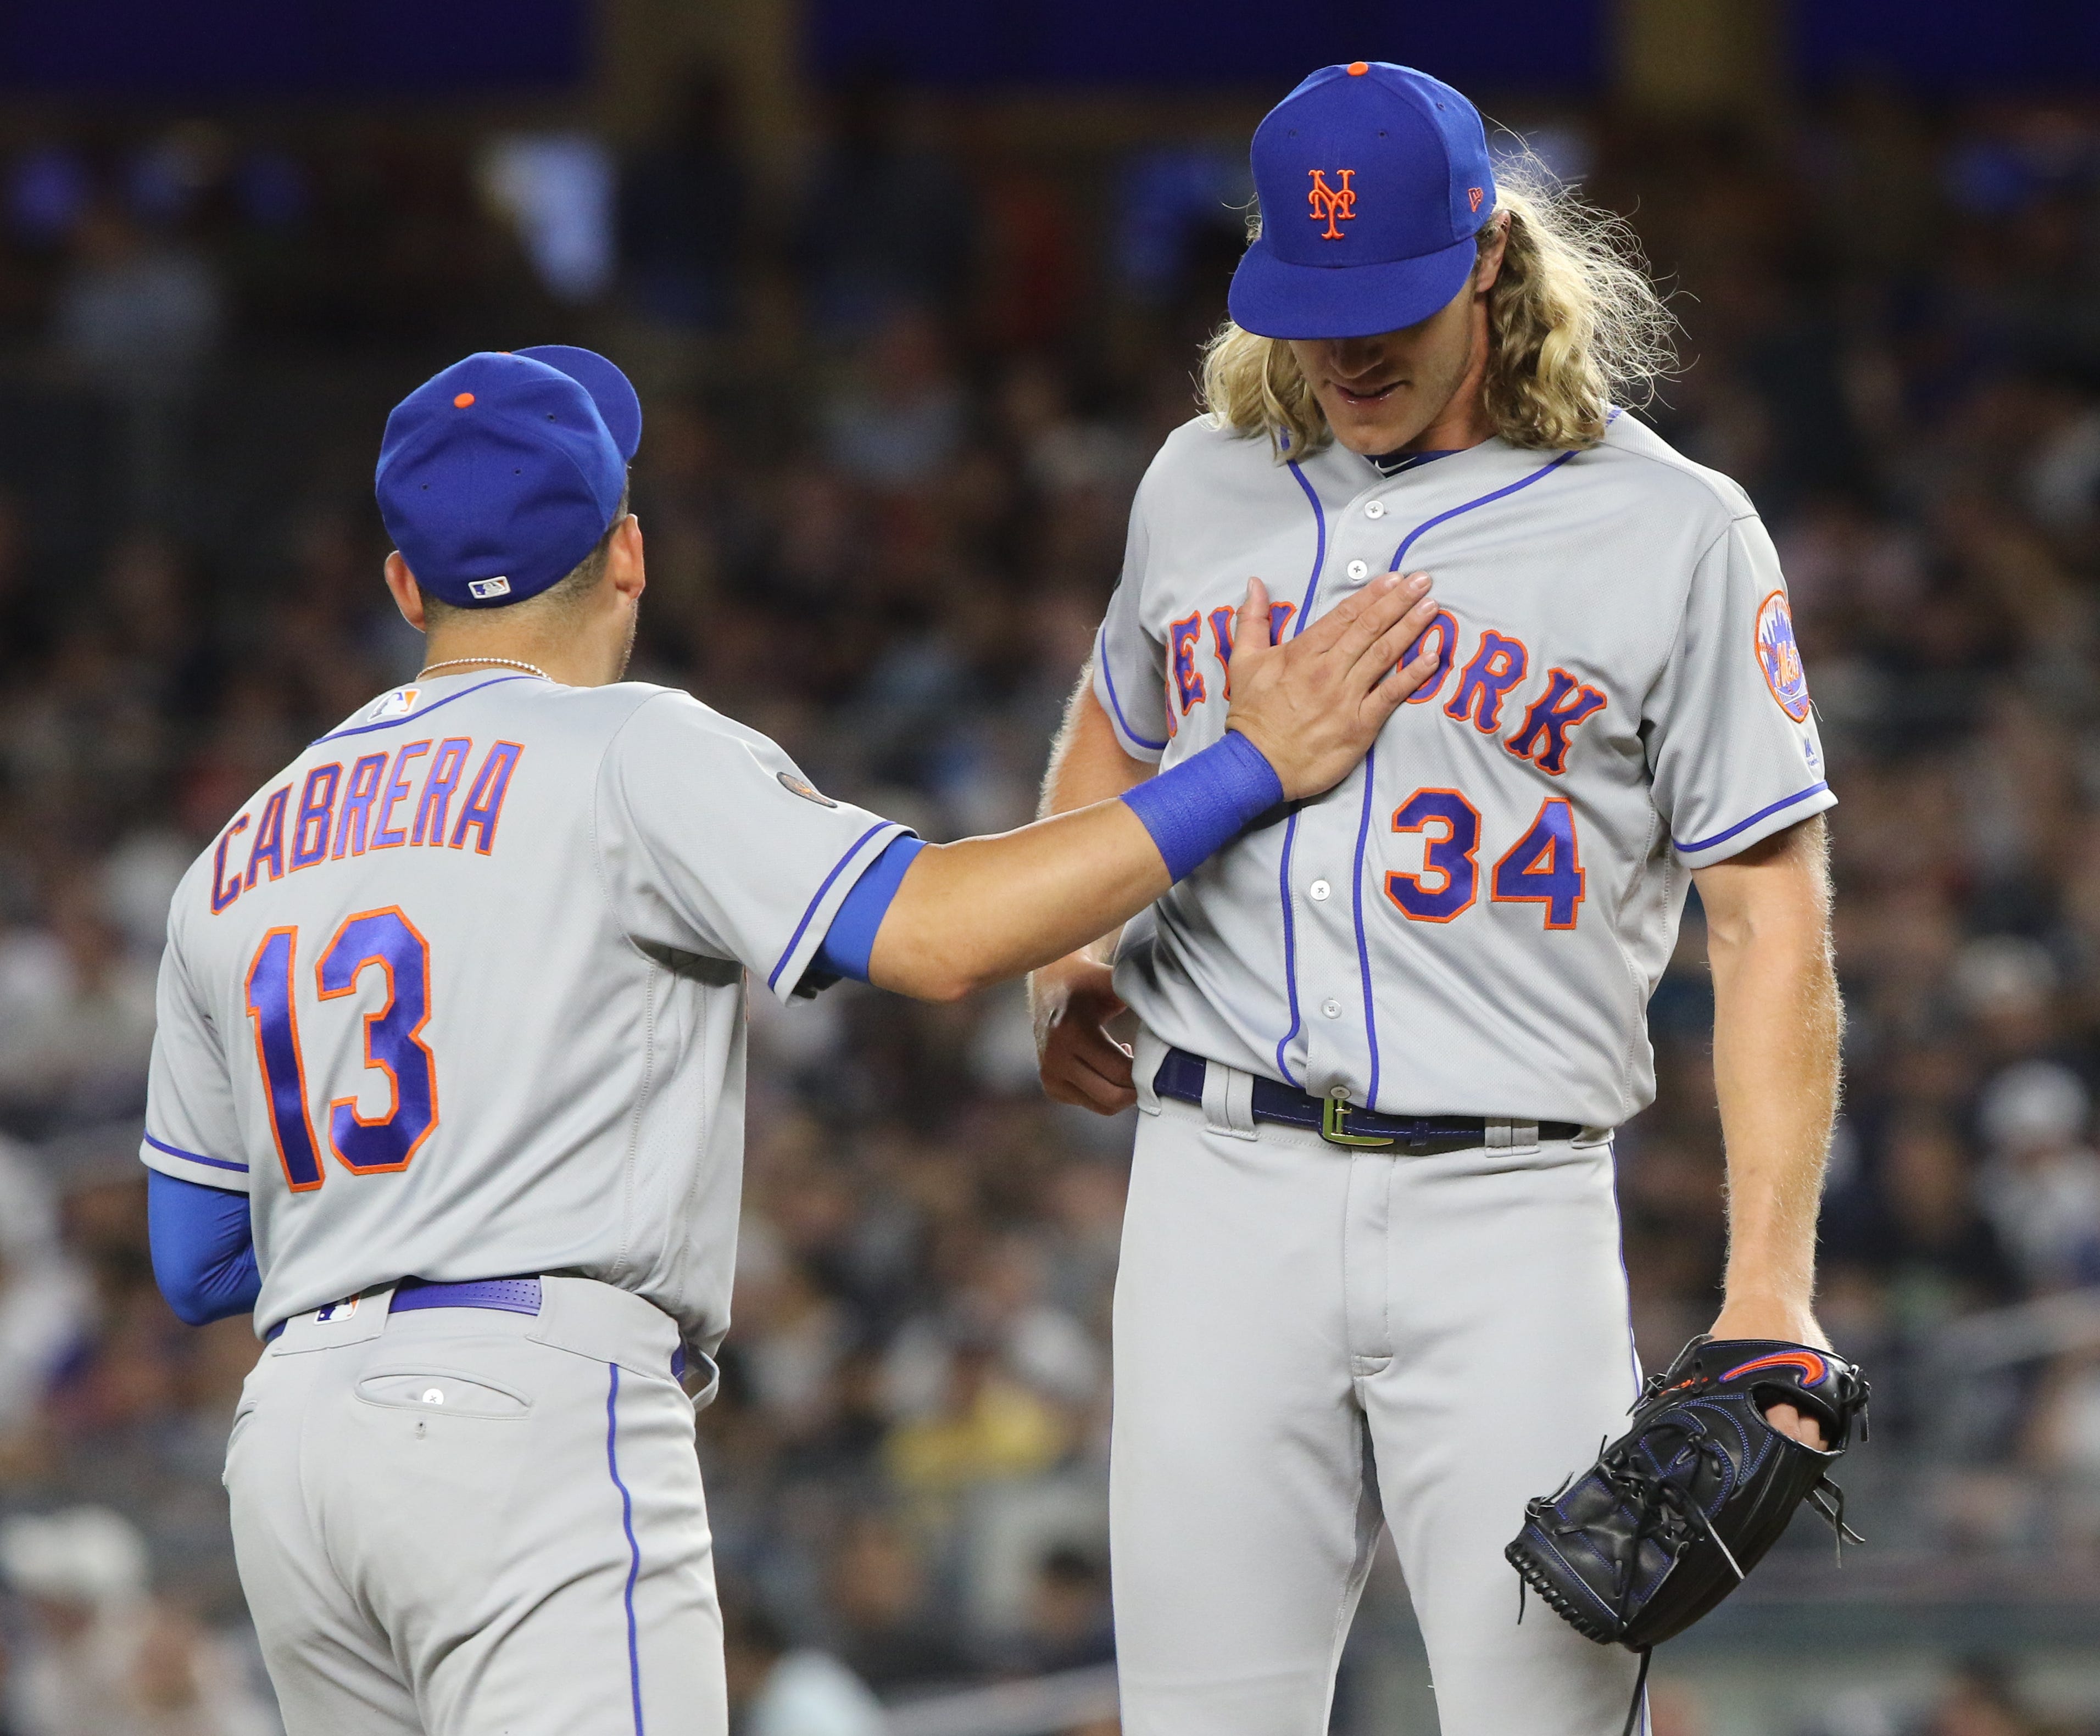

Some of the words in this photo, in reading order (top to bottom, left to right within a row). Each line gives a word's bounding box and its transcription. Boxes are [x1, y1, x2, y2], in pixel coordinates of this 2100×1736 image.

[1395, 609, 1607, 776] ORK
[210, 736, 525, 915] CABRERA
[1385, 787, 1585, 930] 34
[244, 905, 439, 1193] 13
